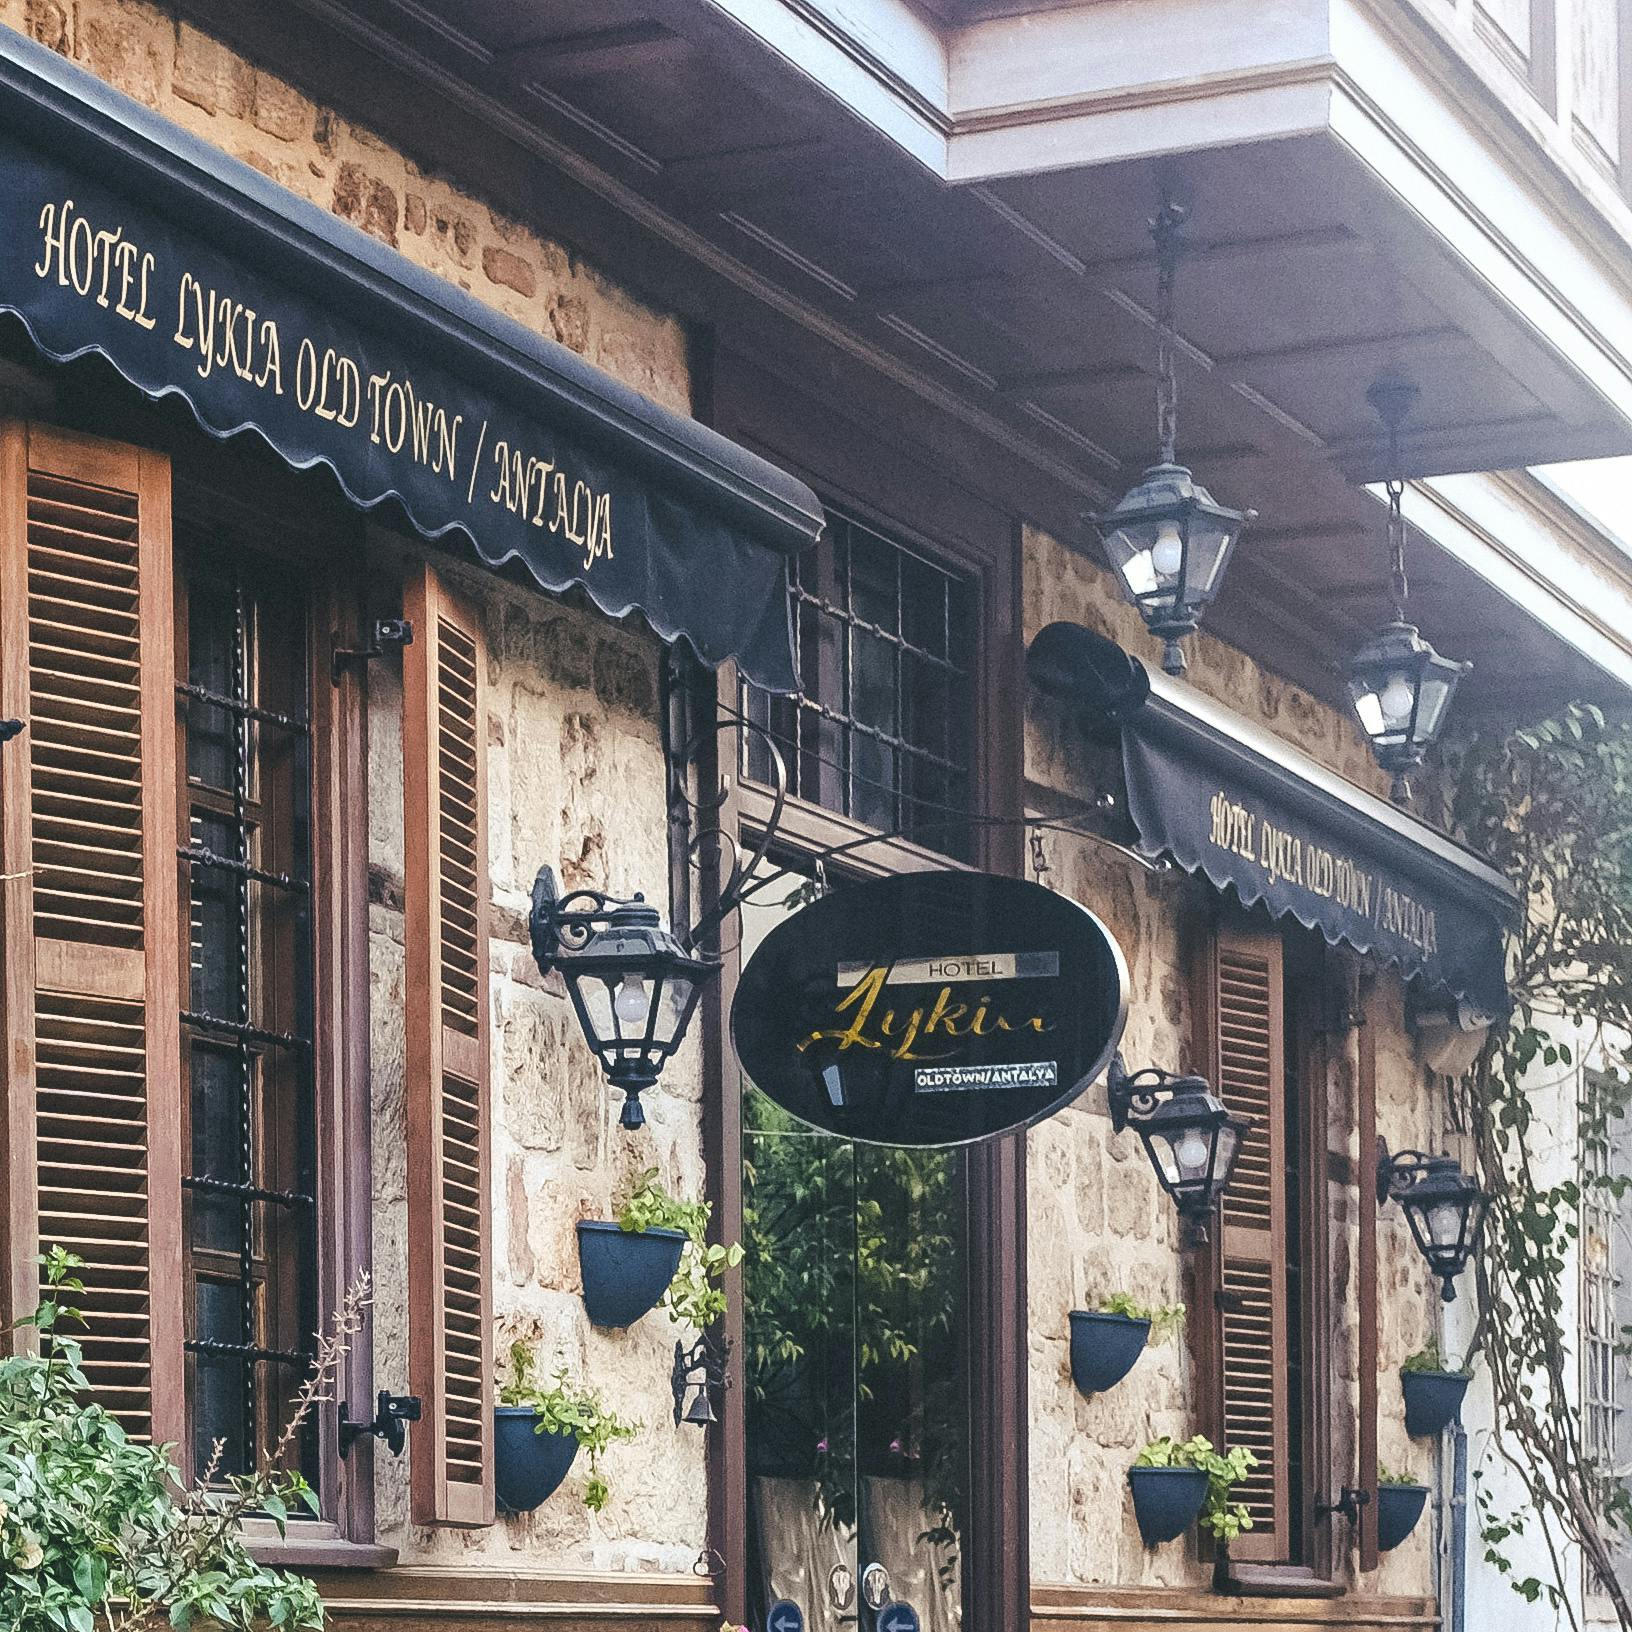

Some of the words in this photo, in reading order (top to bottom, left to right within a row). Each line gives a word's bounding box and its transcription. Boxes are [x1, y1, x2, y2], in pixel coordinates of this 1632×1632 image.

[34, 200, 157, 330] HOTEL
[174, 271, 284, 396] LYKIA
[295, 337, 362, 429] OLD
[367, 371, 463, 482] TOWN
[467, 419, 488, 503] /
[490, 441, 615, 571] ANTALYA
[1208, 790, 1255, 862] HOTEL
[1307, 843, 1334, 898] OLD
[928, 959, 1003, 978] HOTEL
[915, 1067, 1055, 1088] OLDTOWN/ANTALYA
